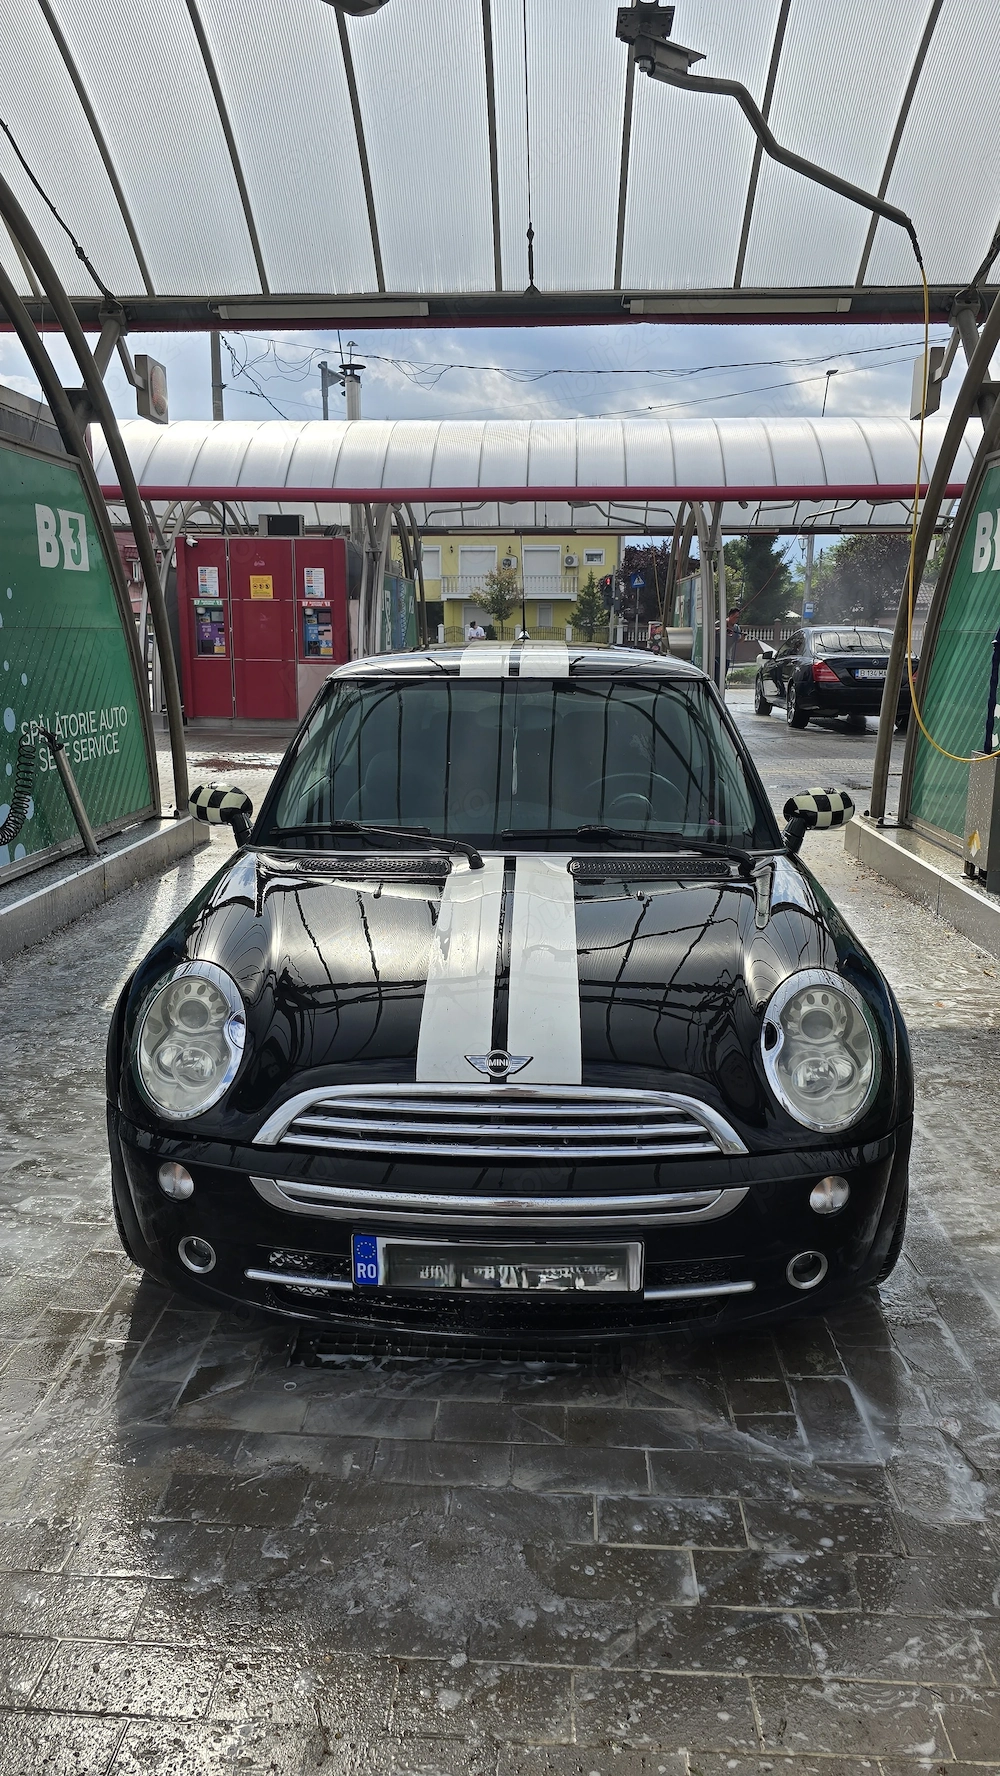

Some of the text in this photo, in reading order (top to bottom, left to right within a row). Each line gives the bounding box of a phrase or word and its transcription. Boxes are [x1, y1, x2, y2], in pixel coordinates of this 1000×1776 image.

[35, 503, 90, 572] B3
[972, 511, 1000, 573] B
[99, 705, 128, 732] AUTO
[38, 731, 120, 772] SEF SERVICE
[487, 1058, 509, 1067] MINI
[356, 1262, 378, 1279] RO
